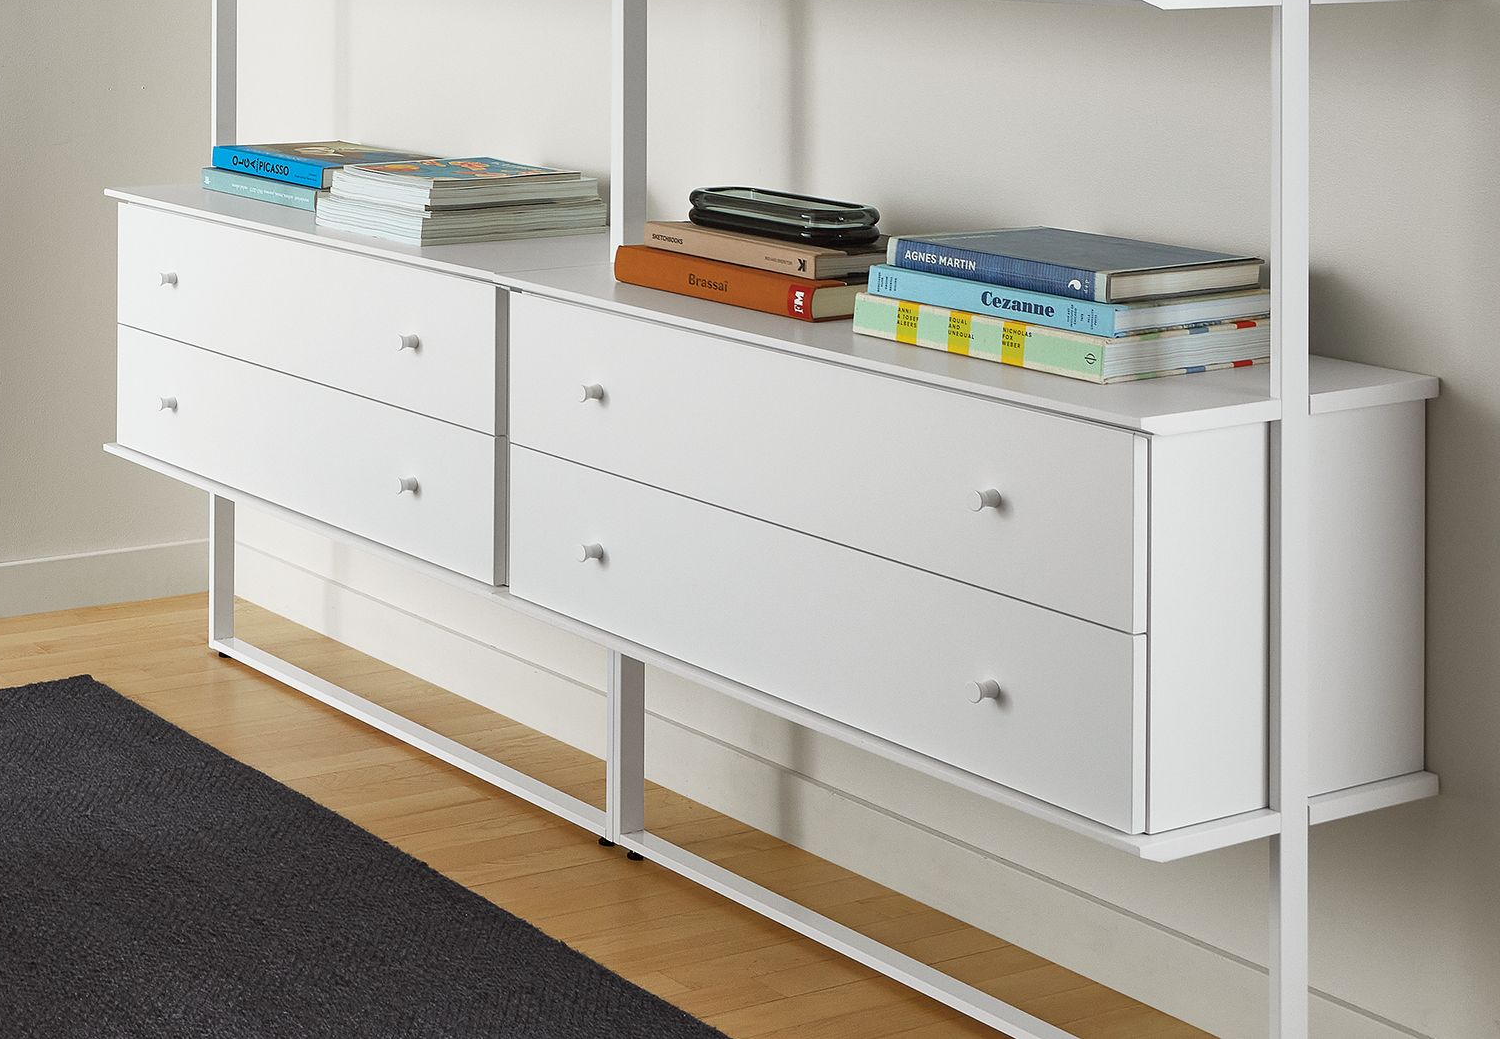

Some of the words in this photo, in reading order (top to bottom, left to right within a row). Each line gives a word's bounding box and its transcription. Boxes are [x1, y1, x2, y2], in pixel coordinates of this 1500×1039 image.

[258, 161, 289, 176] PICASSO
[651, 233, 683, 245] SKETCHBOOKS
[904, 250, 937, 264] AGNES
[938, 255, 976, 271] MARTIN
[688, 273, 729, 293] Brassaï
[793, 291, 805, 314] FM
[981, 291, 1055, 318] Cezanne
[897, 307, 912, 315] ANNI
[896, 319, 917, 329] ALBERS
[902, 314, 919, 323] JOSEF
[949, 316, 968, 326] EQUAL
[948, 323, 961, 331] AND
[1002, 327, 1033, 338] NICHOLAS
[947, 329, 975, 340] UNEQUAL
[1002, 333, 1013, 341] FOX
[1002, 339, 1021, 349] WEBER
